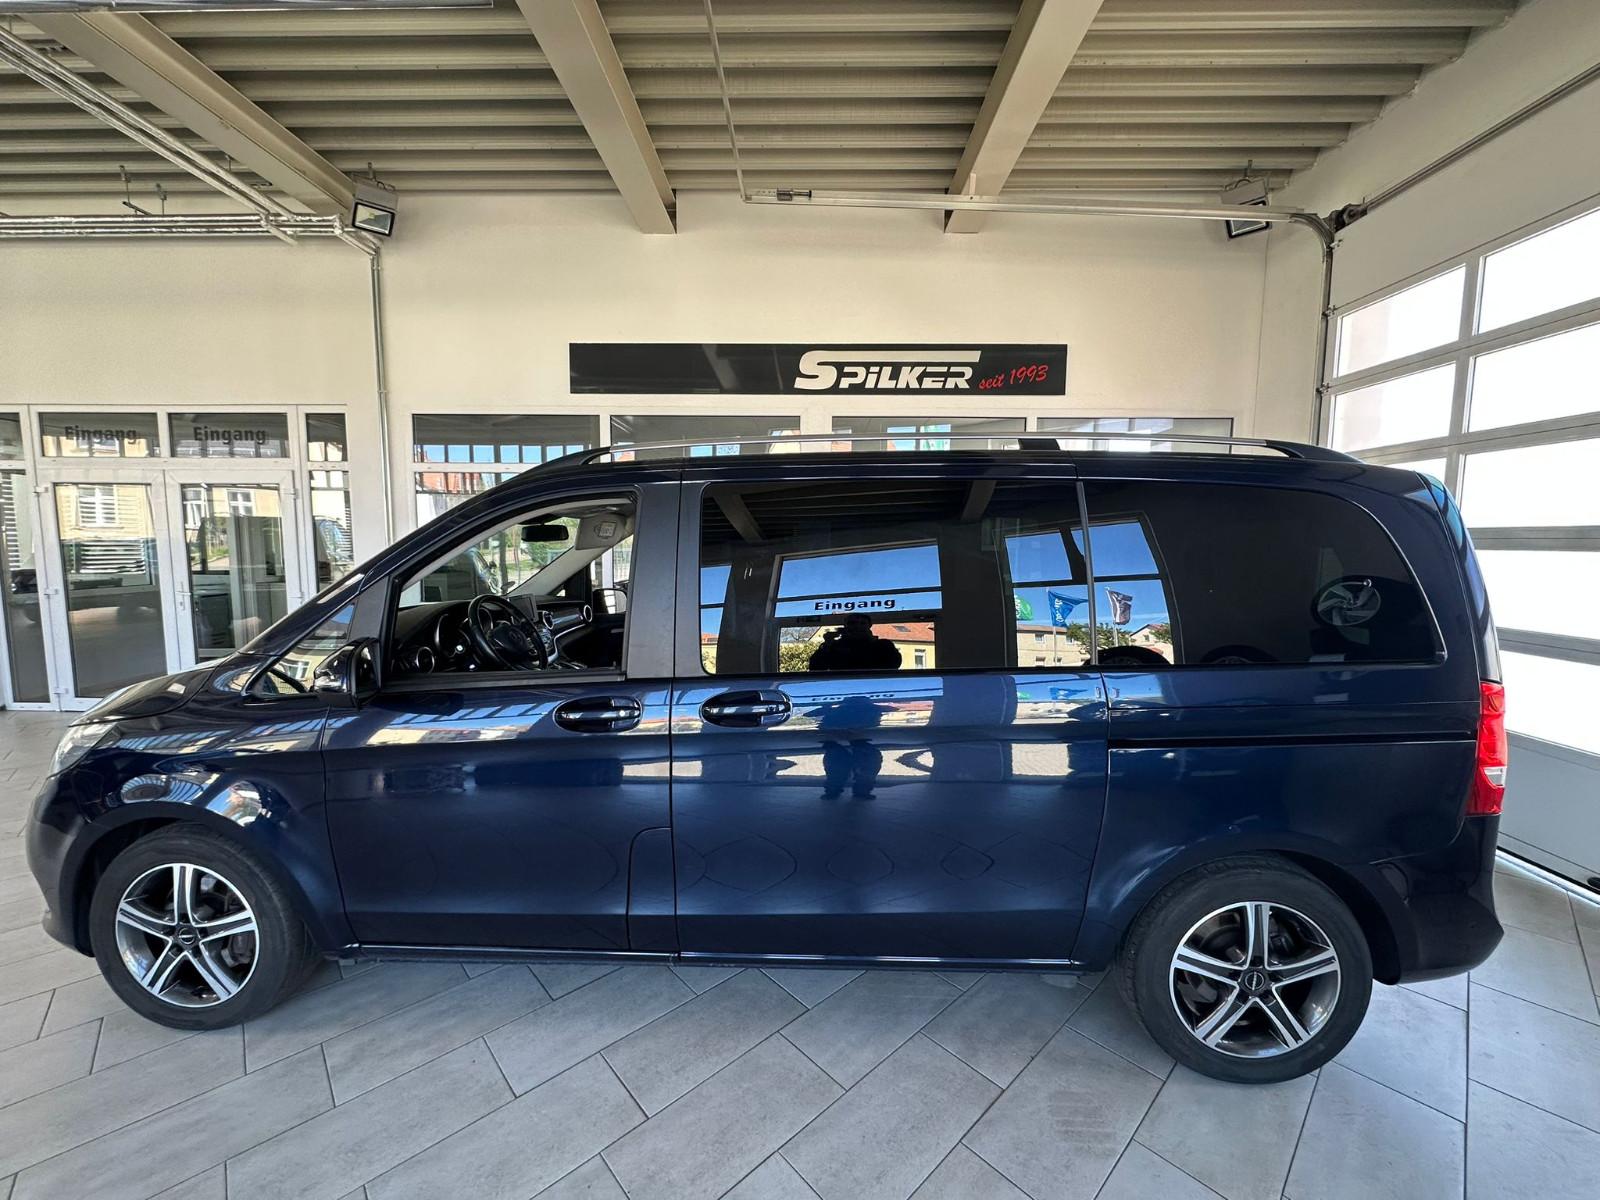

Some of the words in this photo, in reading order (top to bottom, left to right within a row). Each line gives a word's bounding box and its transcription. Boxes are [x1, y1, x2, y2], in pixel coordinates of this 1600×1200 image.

[978, 373, 1004, 389] seit
[1009, 364, 1050, 385] 1993
[64, 425, 138, 445] Eingang
[192, 426, 267, 445] Eingang
[814, 599, 896, 611] Eingang
